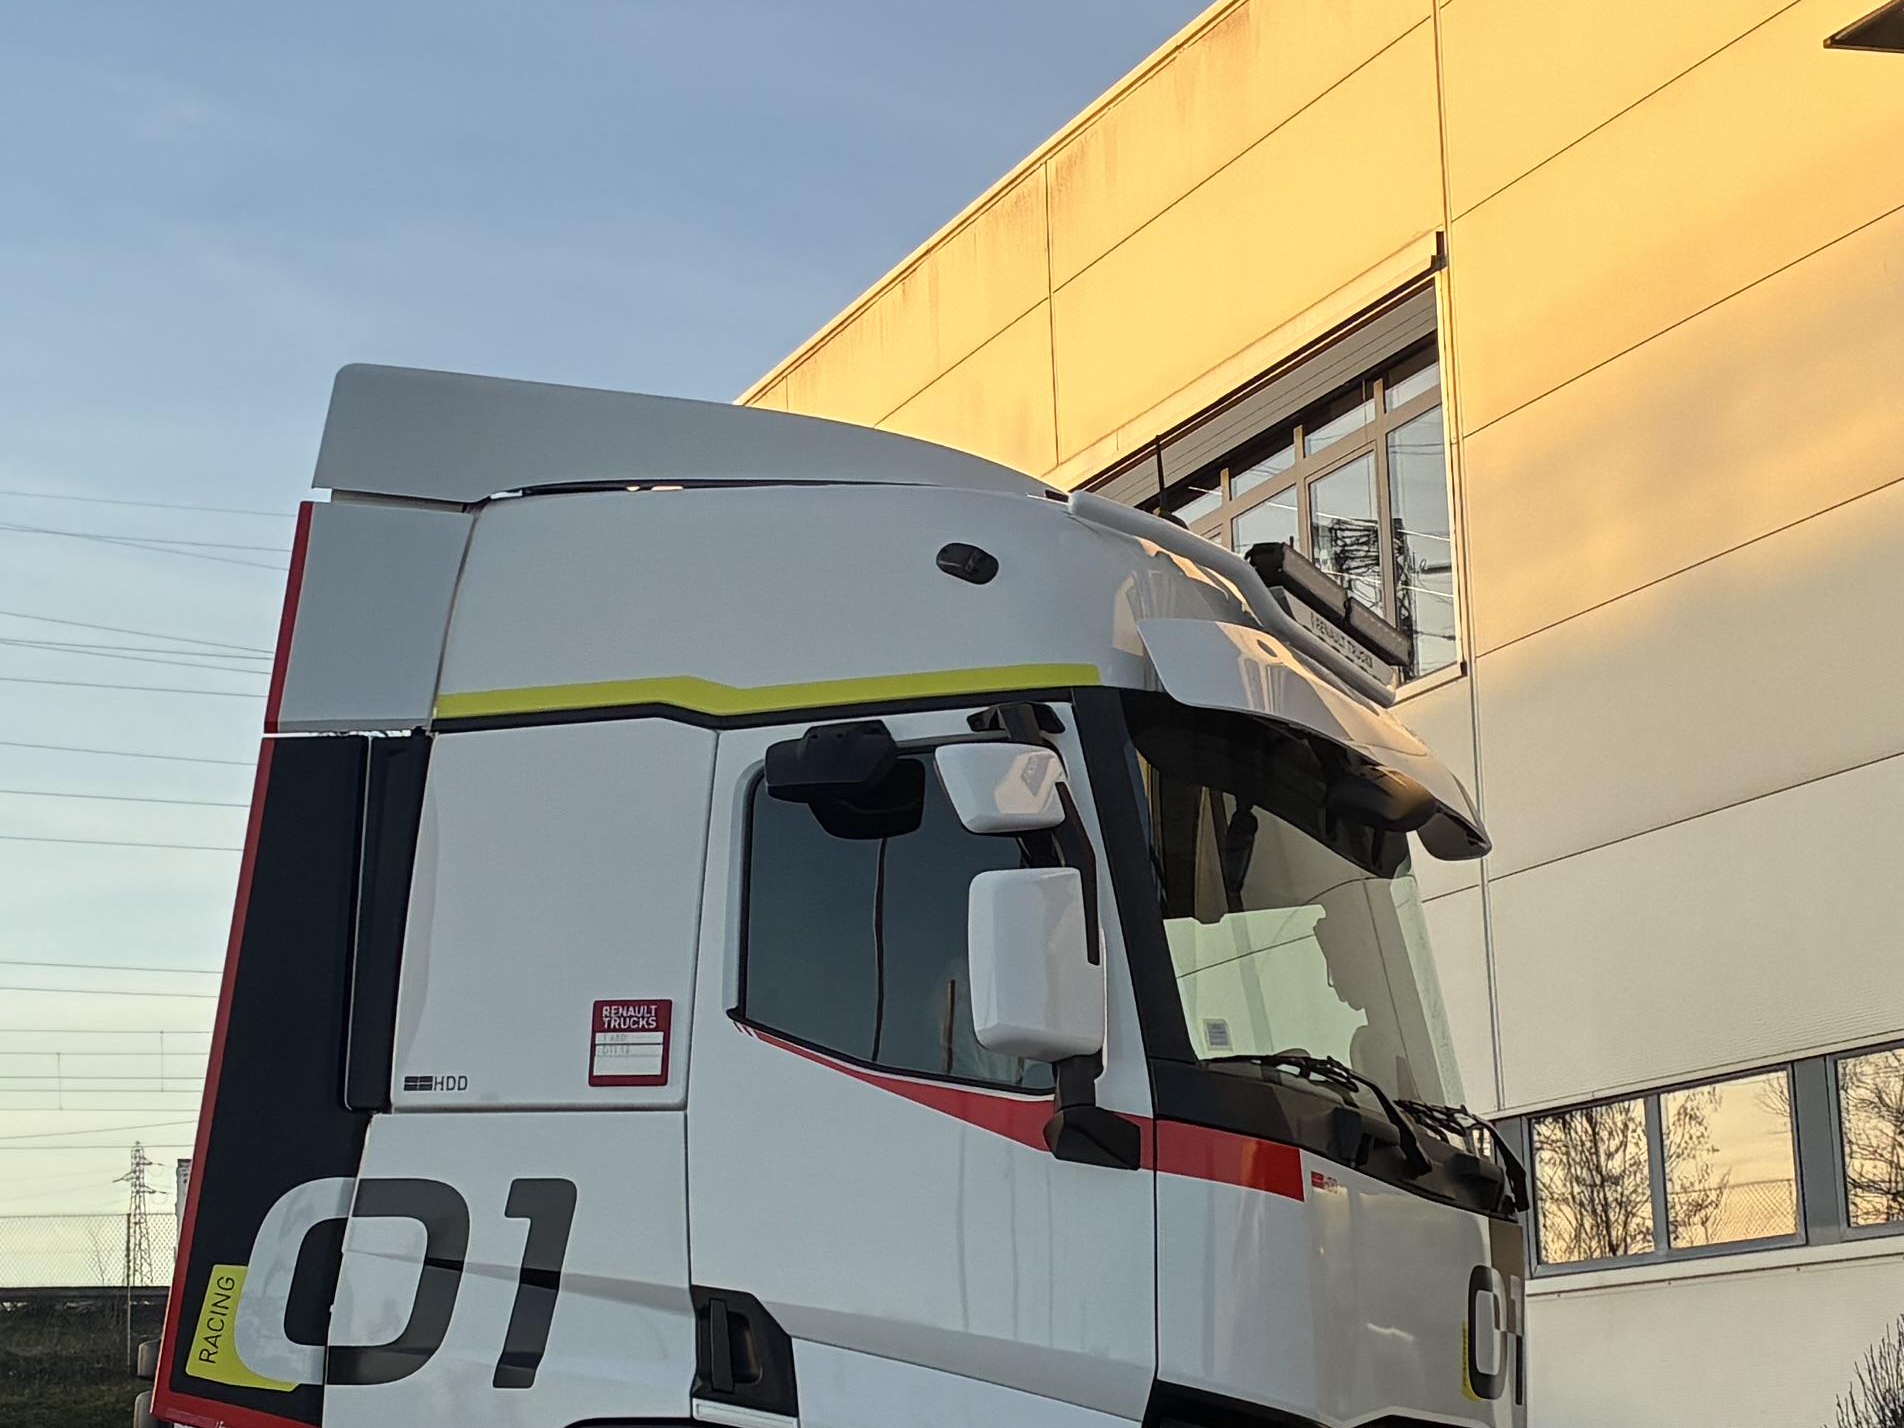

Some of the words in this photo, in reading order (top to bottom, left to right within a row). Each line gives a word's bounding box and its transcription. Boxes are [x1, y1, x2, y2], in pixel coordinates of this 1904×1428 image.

[602, 1005, 657, 1018] RENAULT
[602, 1017, 657, 1029] TRUCKS
[198, 1275, 236, 1364] RACING
